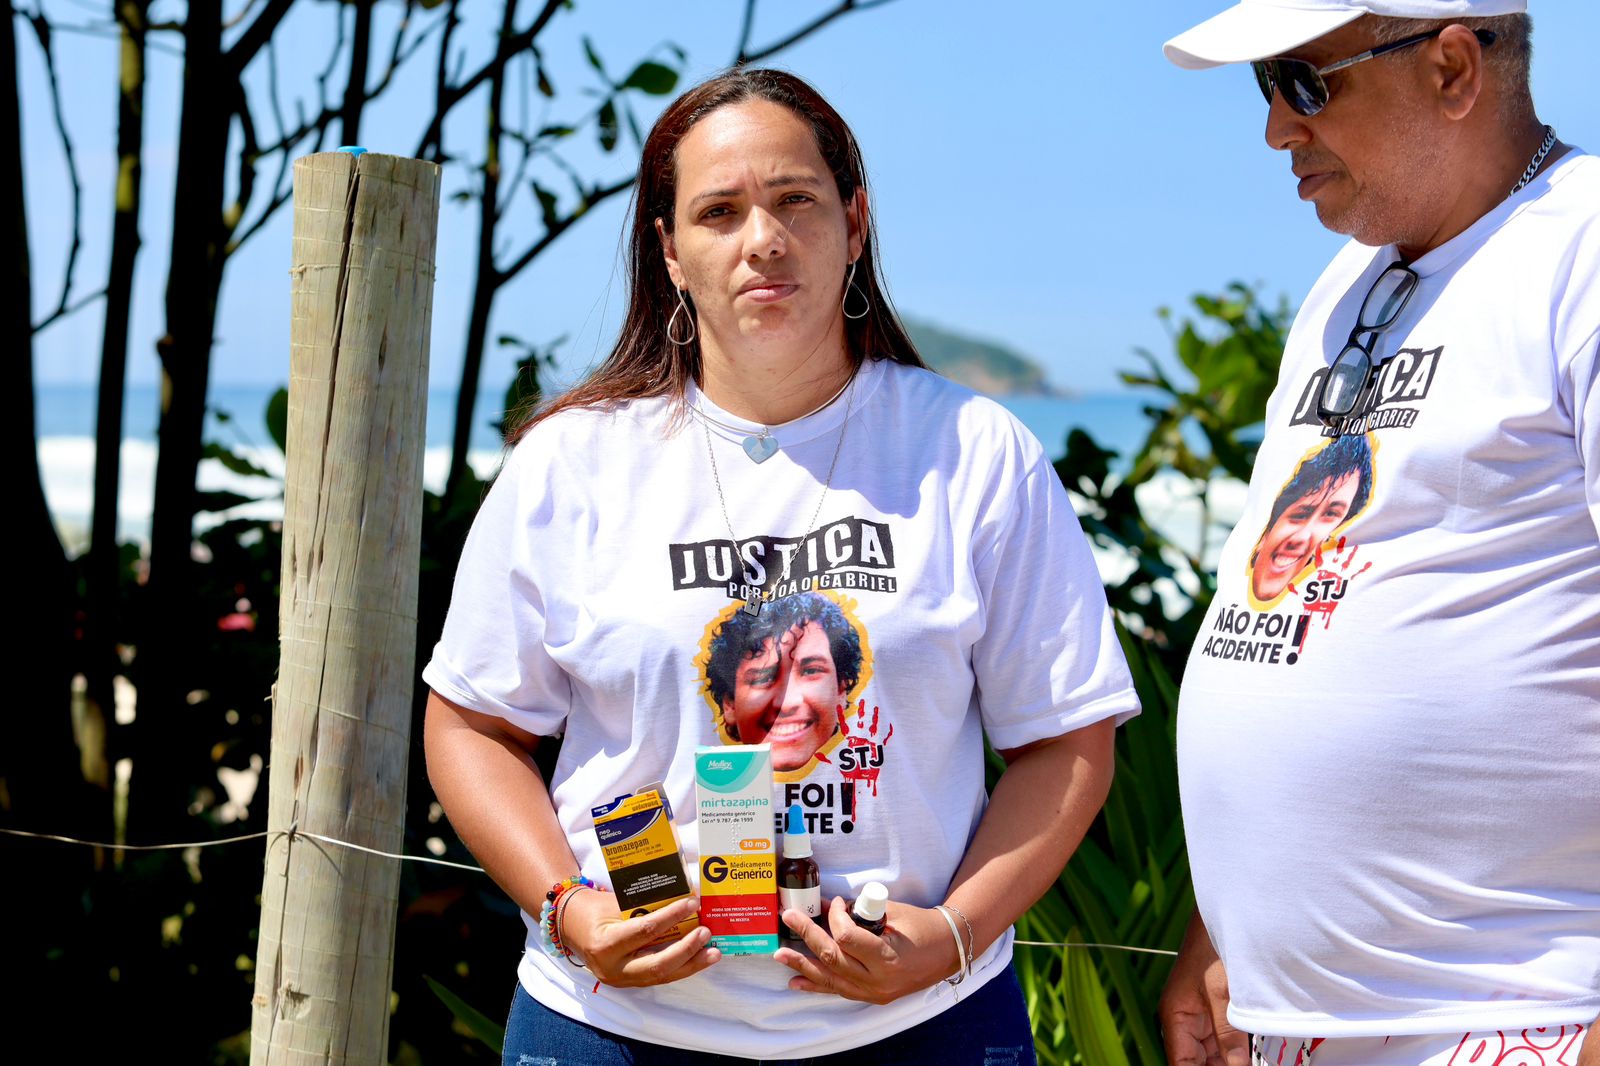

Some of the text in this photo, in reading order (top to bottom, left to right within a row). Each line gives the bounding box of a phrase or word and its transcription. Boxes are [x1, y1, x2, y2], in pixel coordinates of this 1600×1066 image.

[1369, 409, 1418, 428] GABRIEL
[680, 522, 888, 586] JUSTIÇA
[729, 581, 761, 600] POR
[820, 572, 896, 592] GABRIEL
[1303, 579, 1349, 603] STJ
[1213, 604, 1293, 638] NÃO FOI
[1202, 636, 1283, 664] ACIDENTE
[839, 744, 884, 770] STJ
[701, 796, 769, 808] mirtazapina
[785, 783, 834, 808] FOI
[604, 837, 650, 856] bromazepam
[755, 841, 767, 849] mg
[702, 856, 729, 884] G
[730, 867, 773, 880] Genérico
